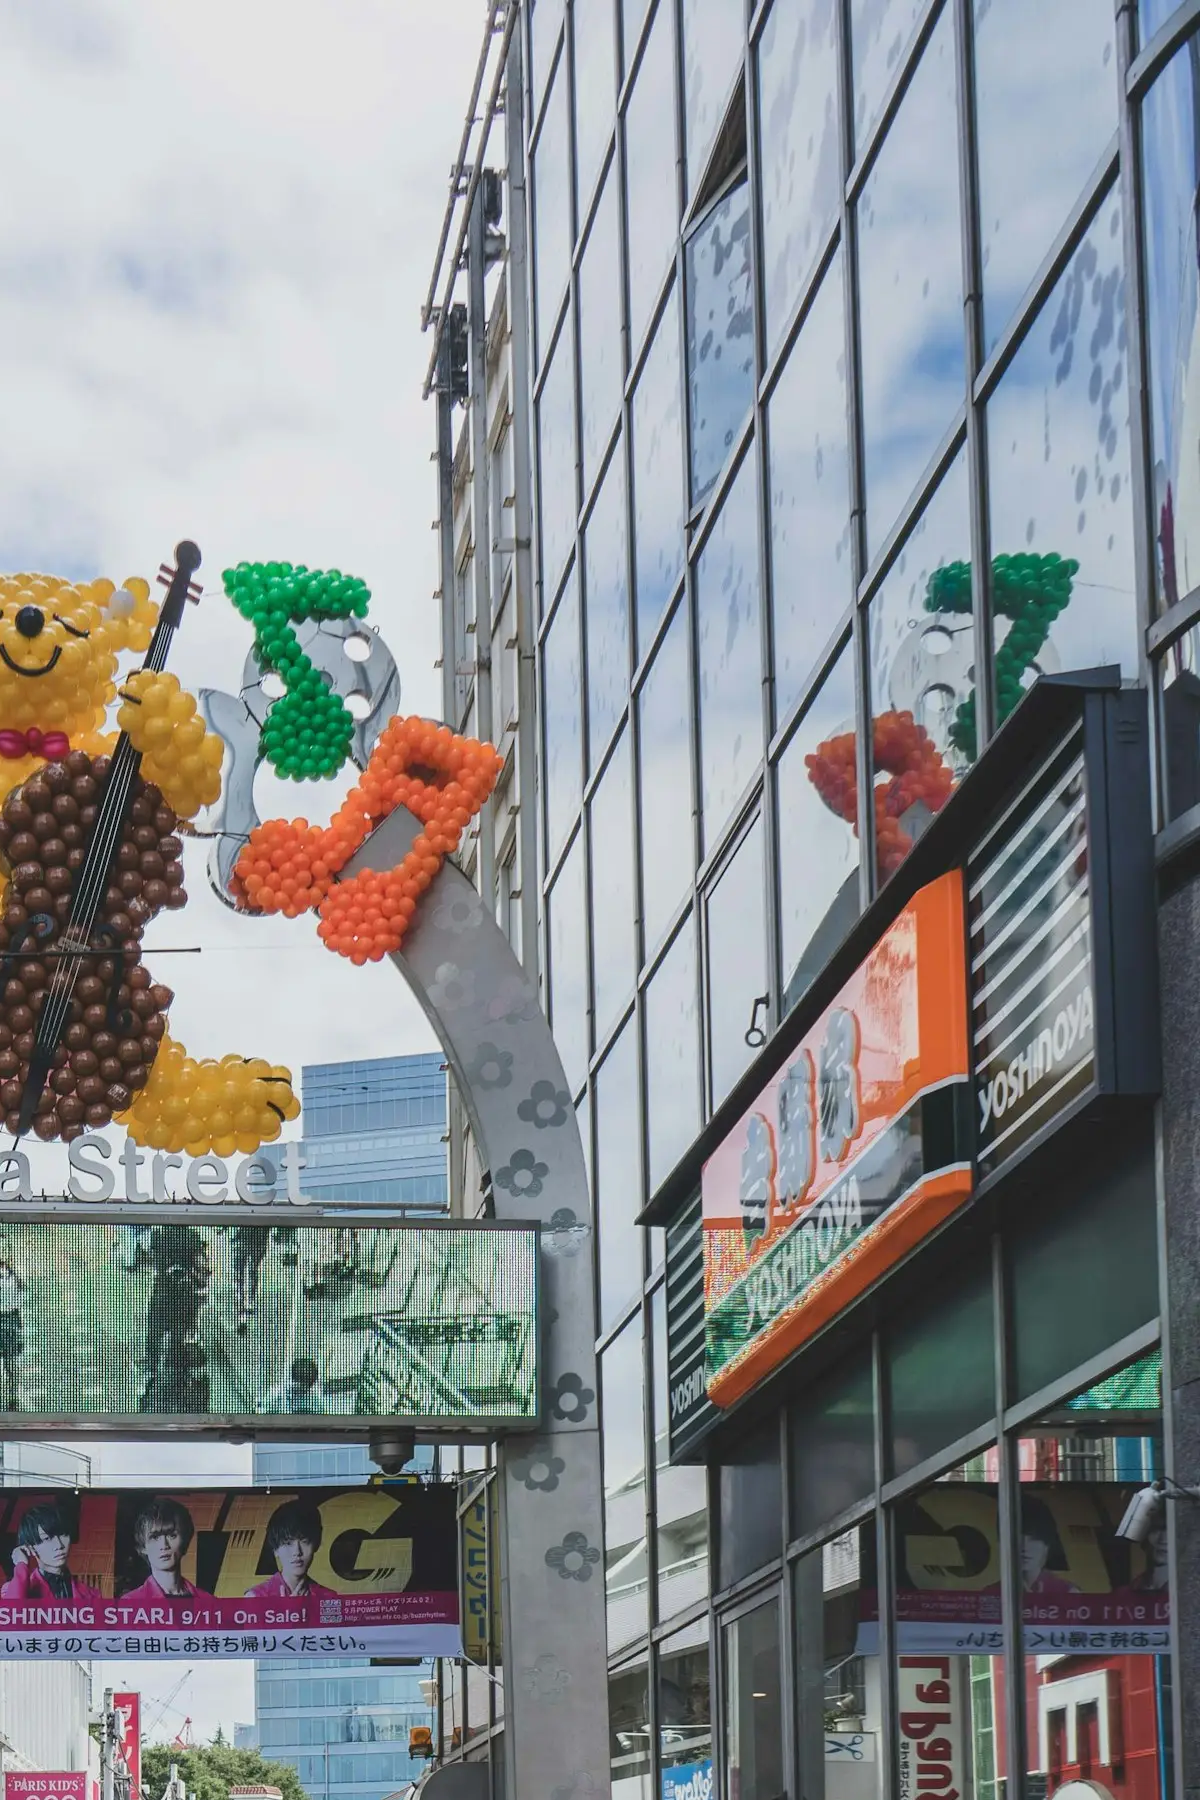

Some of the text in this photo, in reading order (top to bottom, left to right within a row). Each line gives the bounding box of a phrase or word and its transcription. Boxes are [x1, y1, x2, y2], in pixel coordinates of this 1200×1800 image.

[978, 985, 1094, 1134] YOSHINOYA
[68, 1134, 311, 1206] Street
[744, 1174, 863, 1336] YOSHINOYA
[181, 1609, 222, 1626] 9/11
[234, 1609, 258, 1625] On
[264, 1607, 307, 1625] Sale!
[13, 1776, 80, 1792] PARIS KID'S
